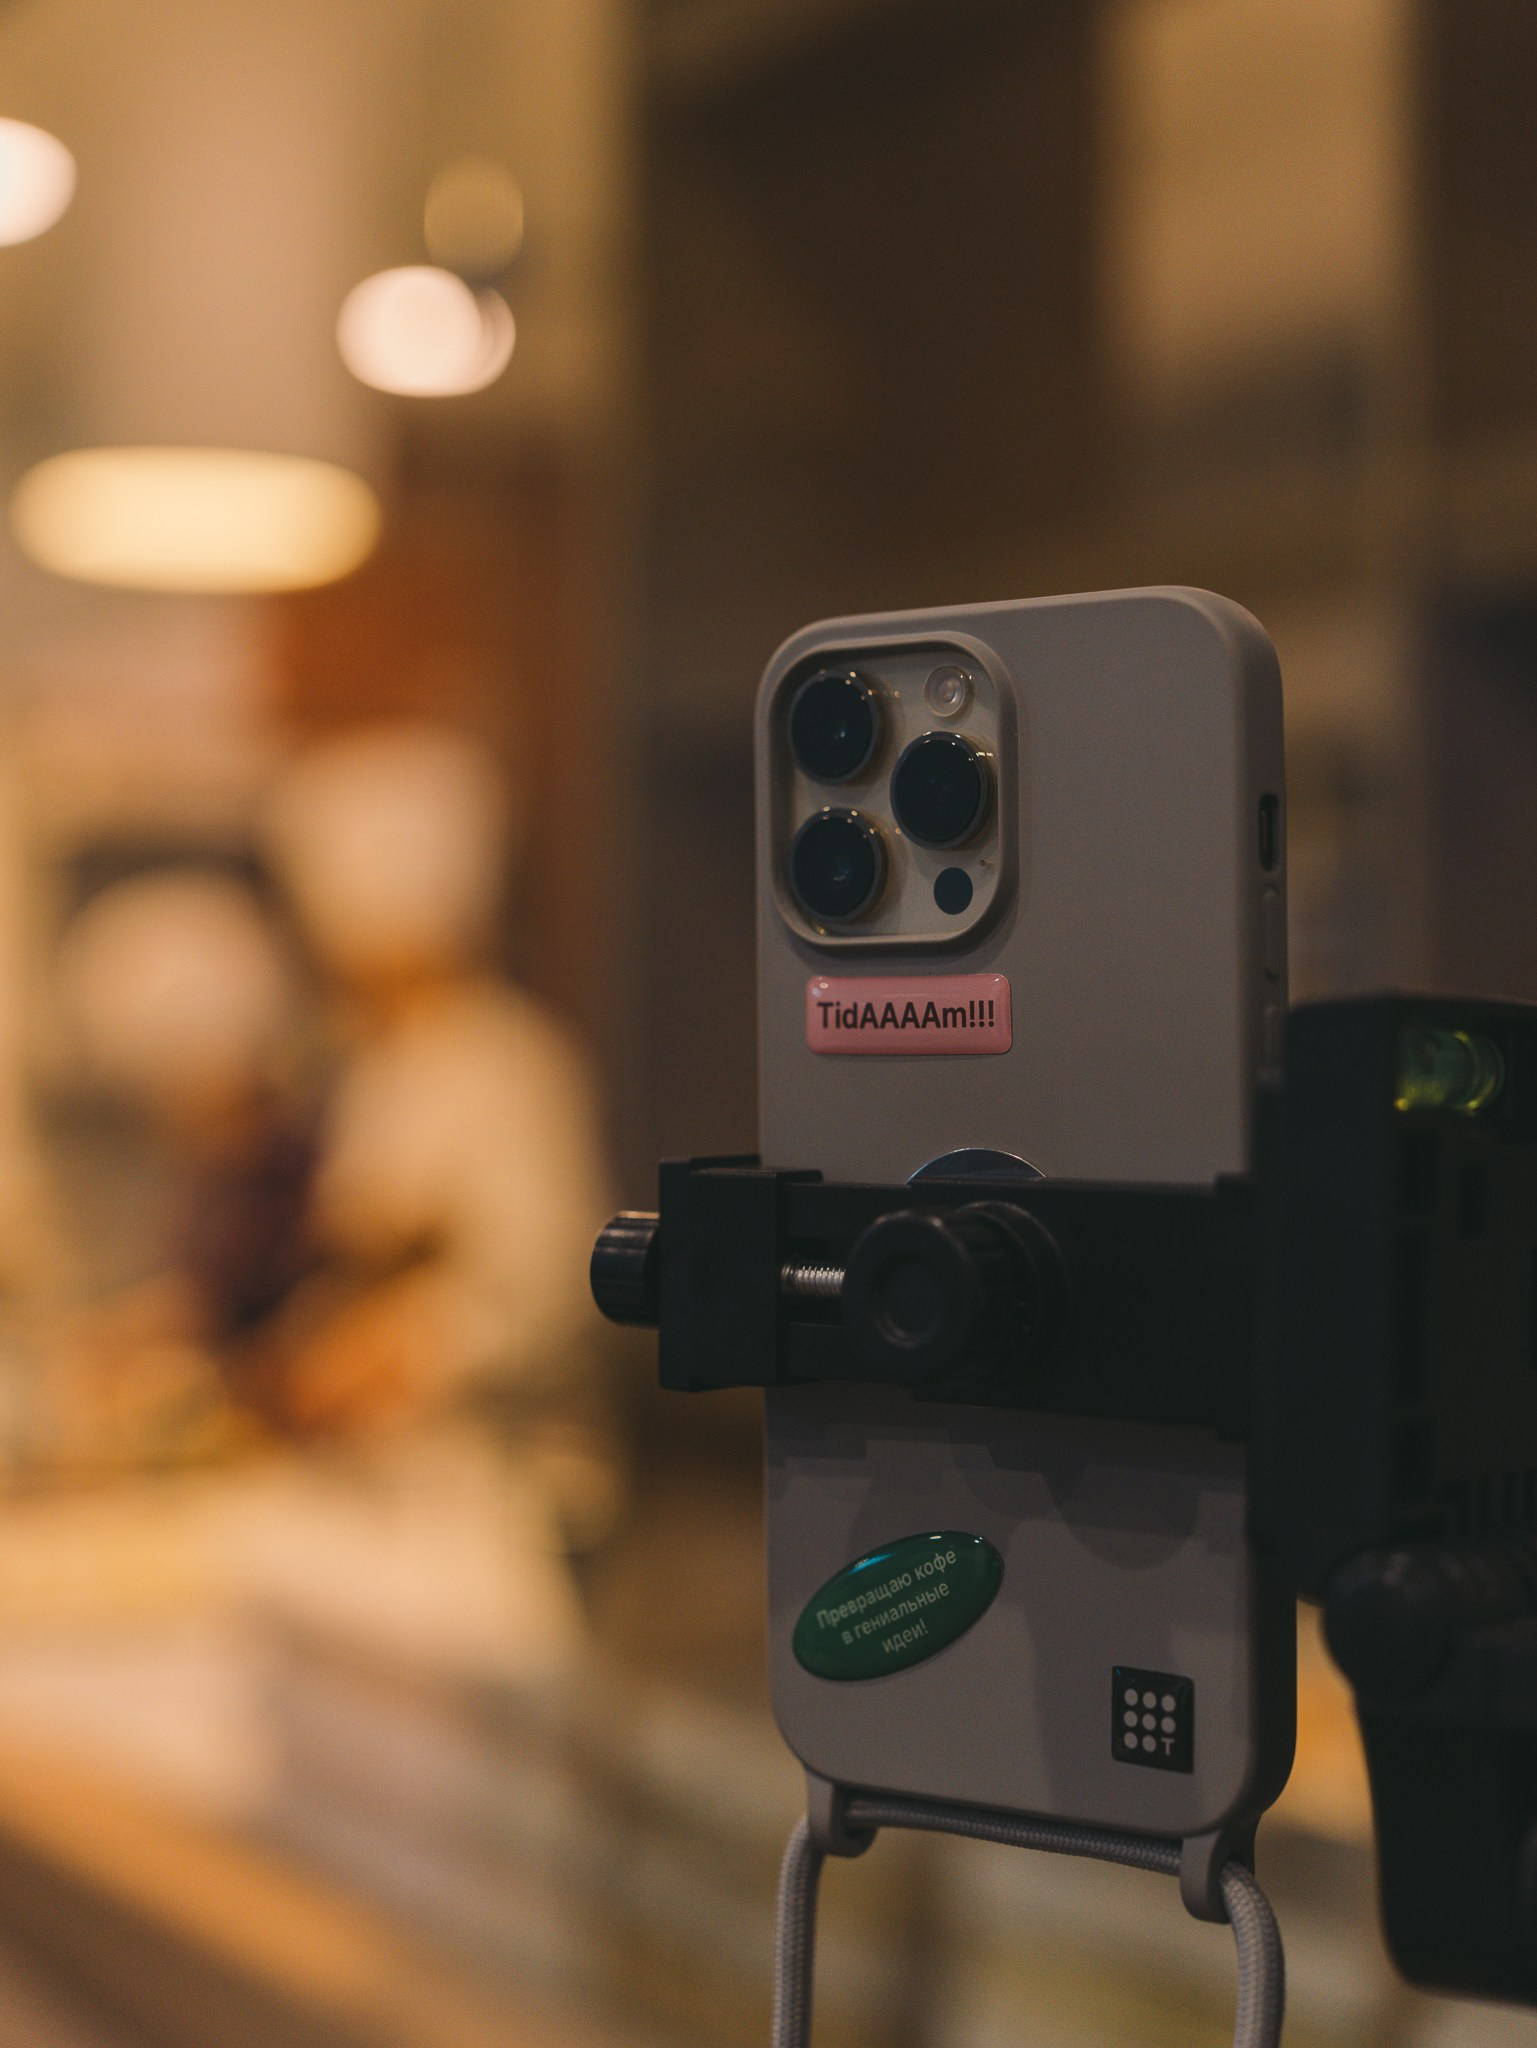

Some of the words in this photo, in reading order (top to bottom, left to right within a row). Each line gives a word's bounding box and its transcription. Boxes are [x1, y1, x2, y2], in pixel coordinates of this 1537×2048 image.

[816, 1571, 912, 1629] Превращаю
[914, 1550, 958, 1581] кофе
[841, 1630, 854, 1645] в
[853, 1582, 951, 1639] гениальные
[881, 1619, 929, 1654] идеи!
